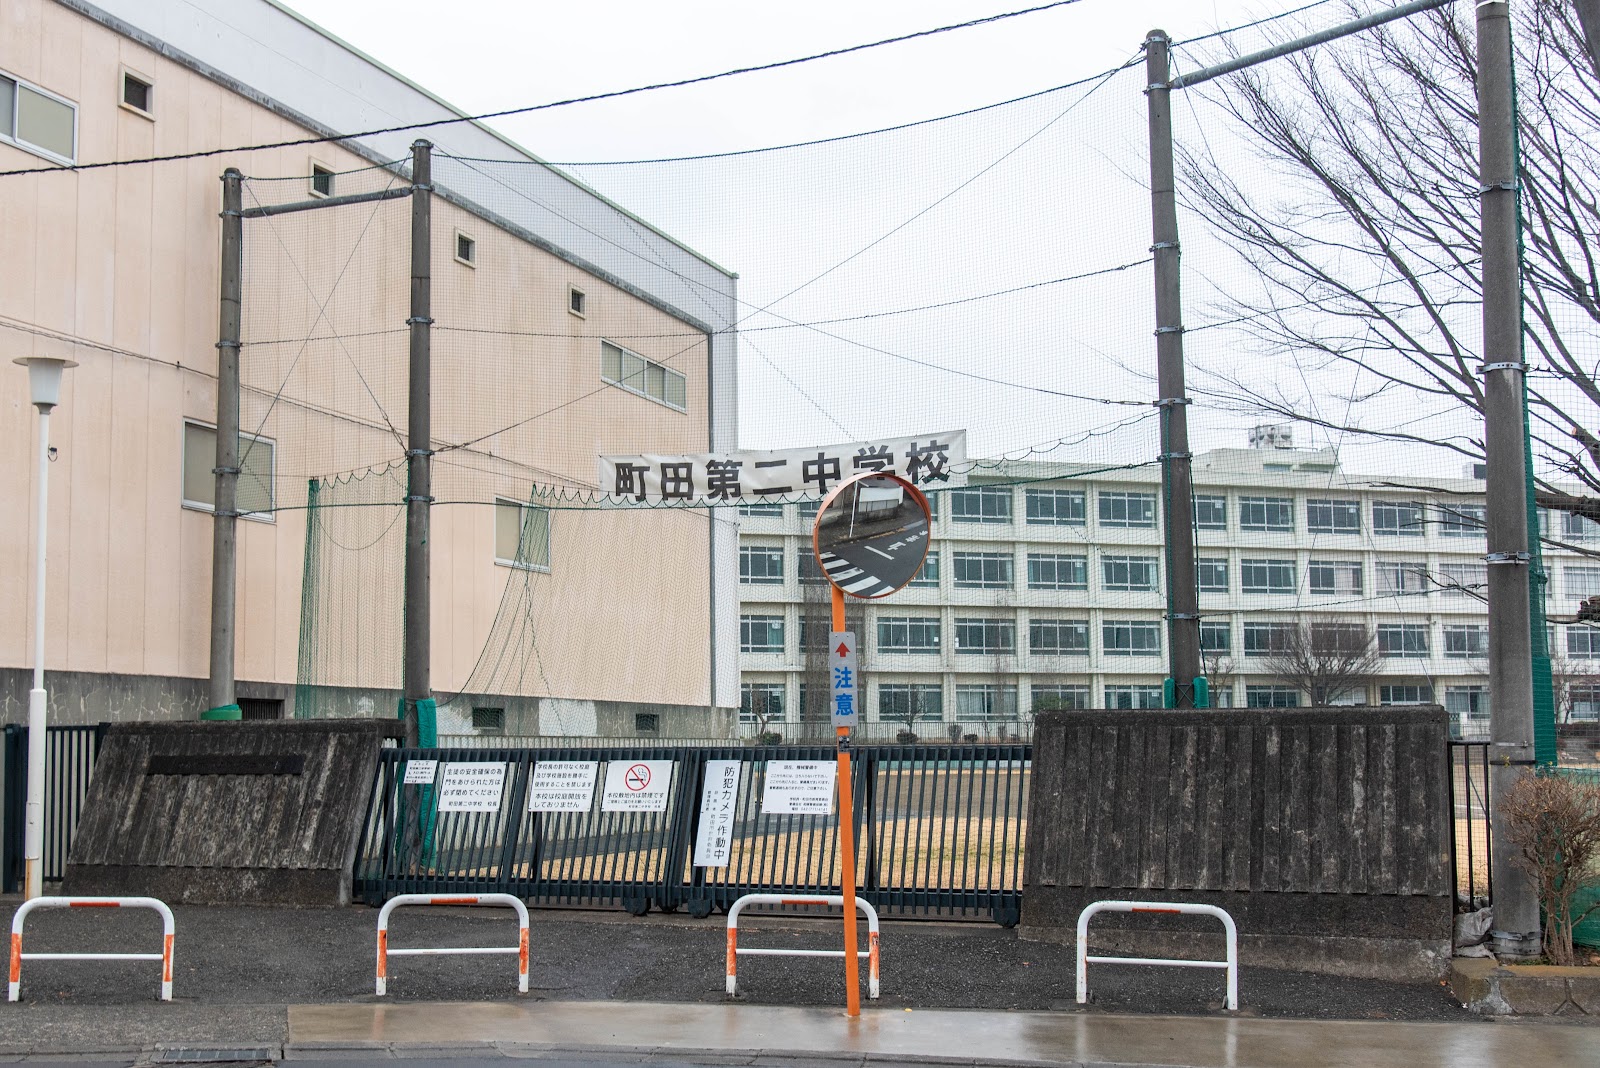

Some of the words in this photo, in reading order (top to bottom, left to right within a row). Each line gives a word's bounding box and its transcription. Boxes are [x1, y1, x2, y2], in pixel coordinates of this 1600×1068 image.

[614, 440, 950, 502] 町田第二中学校
[834, 666, 854, 716] 注意
[446, 768, 503, 776] 生徒の安全確保の為
[713, 766, 736, 860] 防犯カメラ作動中
